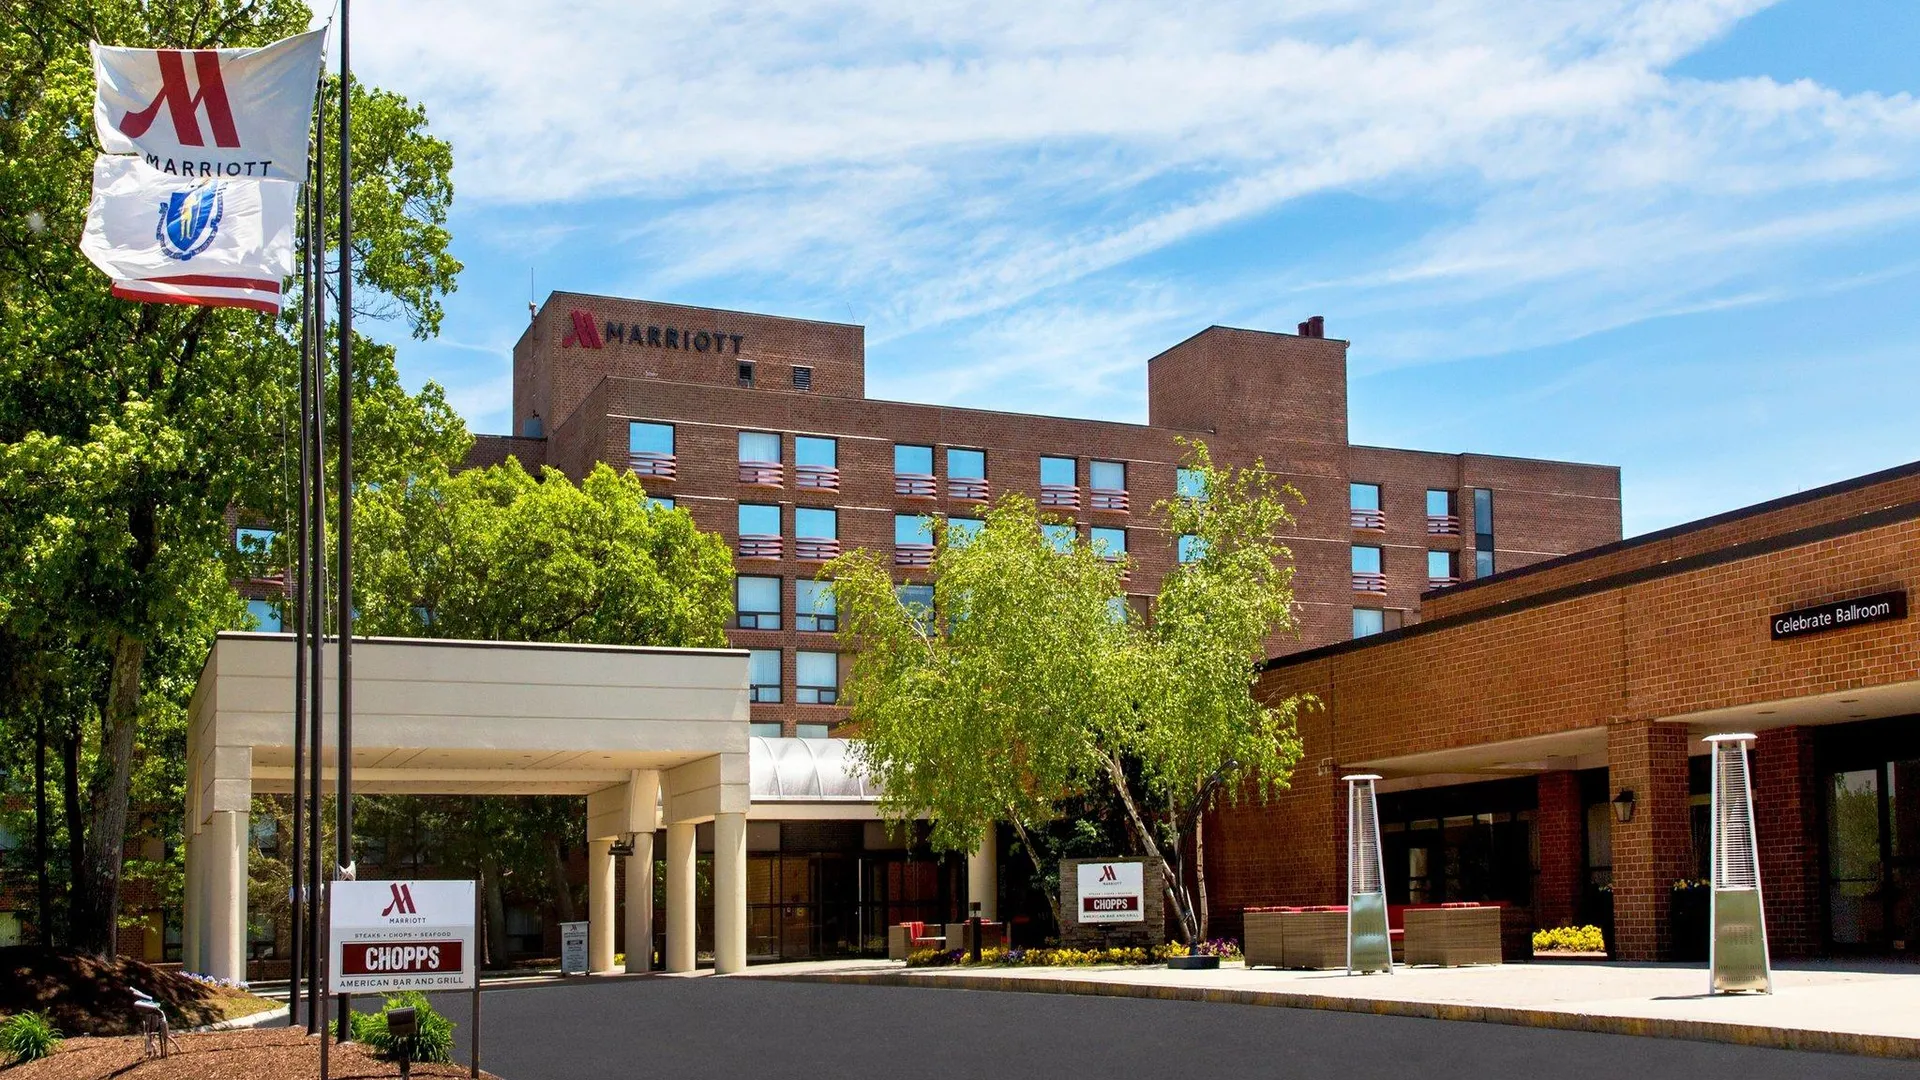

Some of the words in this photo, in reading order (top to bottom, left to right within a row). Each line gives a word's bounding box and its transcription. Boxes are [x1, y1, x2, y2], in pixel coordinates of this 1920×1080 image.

[146, 153, 272, 177] MARRIOTT
[605, 321, 744, 354] MARRIOTT
[1775, 613, 1832, 634] Celebrate
[1836, 602, 1890, 623] Ballroom
[1093, 898, 1128, 910] CHOPPS
[365, 946, 440, 971] CHOPPS
[340, 979, 389, 988] AMERICAN
[437, 976, 464, 984] GRILL
